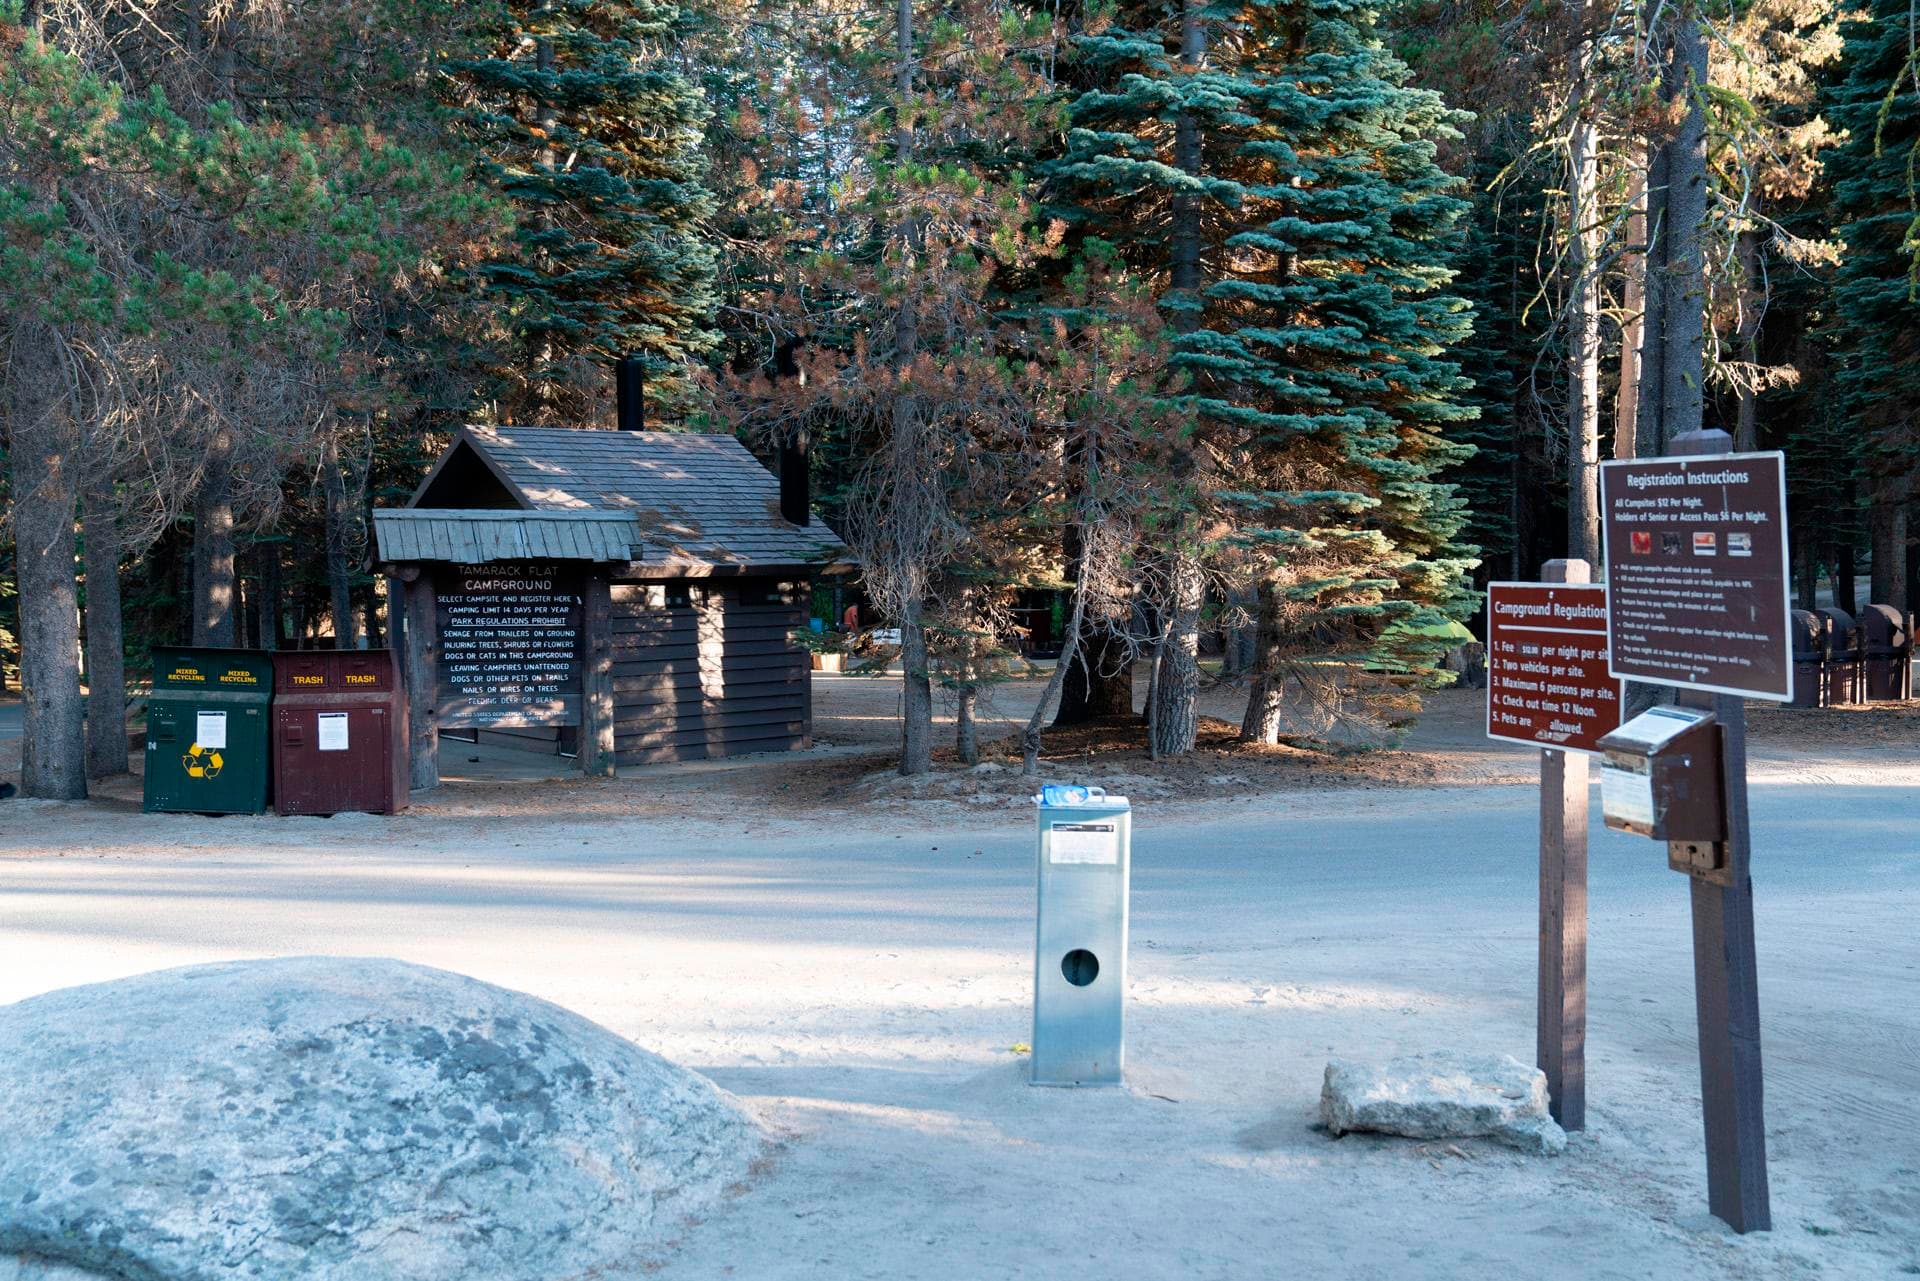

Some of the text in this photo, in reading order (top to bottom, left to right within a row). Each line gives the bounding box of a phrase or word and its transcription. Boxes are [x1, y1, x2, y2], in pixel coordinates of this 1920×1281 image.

[1627, 469, 1748, 489] Registration Instructions
[1624, 498, 1655, 509] Campsites
[1657, 497, 1669, 507] $12
[1670, 498, 1681, 506] Per
[1683, 497, 1703, 508] Night.
[1615, 513, 1638, 521] Holders
[1640, 512, 1646, 521] of
[1648, 512, 1668, 521] Senior
[1680, 512, 1701, 521] Access
[1704, 512, 1718, 521] Pass
[1732, 512, 1744, 520] Per
[1746, 511, 1768, 524] Night.
[459, 566, 558, 576] TAMARACK FLAT
[465, 580, 551, 590] CAMPGROUND
[1495, 601, 1606, 620] Campground Regulation
[1494, 641, 1500, 651] 1.
[1502, 641, 1514, 652] Fee
[1542, 646, 1555, 658] per
[1558, 646, 1578, 660] night
[1581, 649, 1595, 661] per
[1598, 648, 1608, 660] sit
[1494, 659, 1586, 677] 2. Two vehicles per site.
[346, 675, 376, 683] TRASH
[1493, 676, 1616, 700] 3. Maximum 6 persons per site.
[1493, 694, 1597, 717] 4. Check out time 12 Noon.
[1493, 711, 1584, 734] 5. Pets are allowed.
